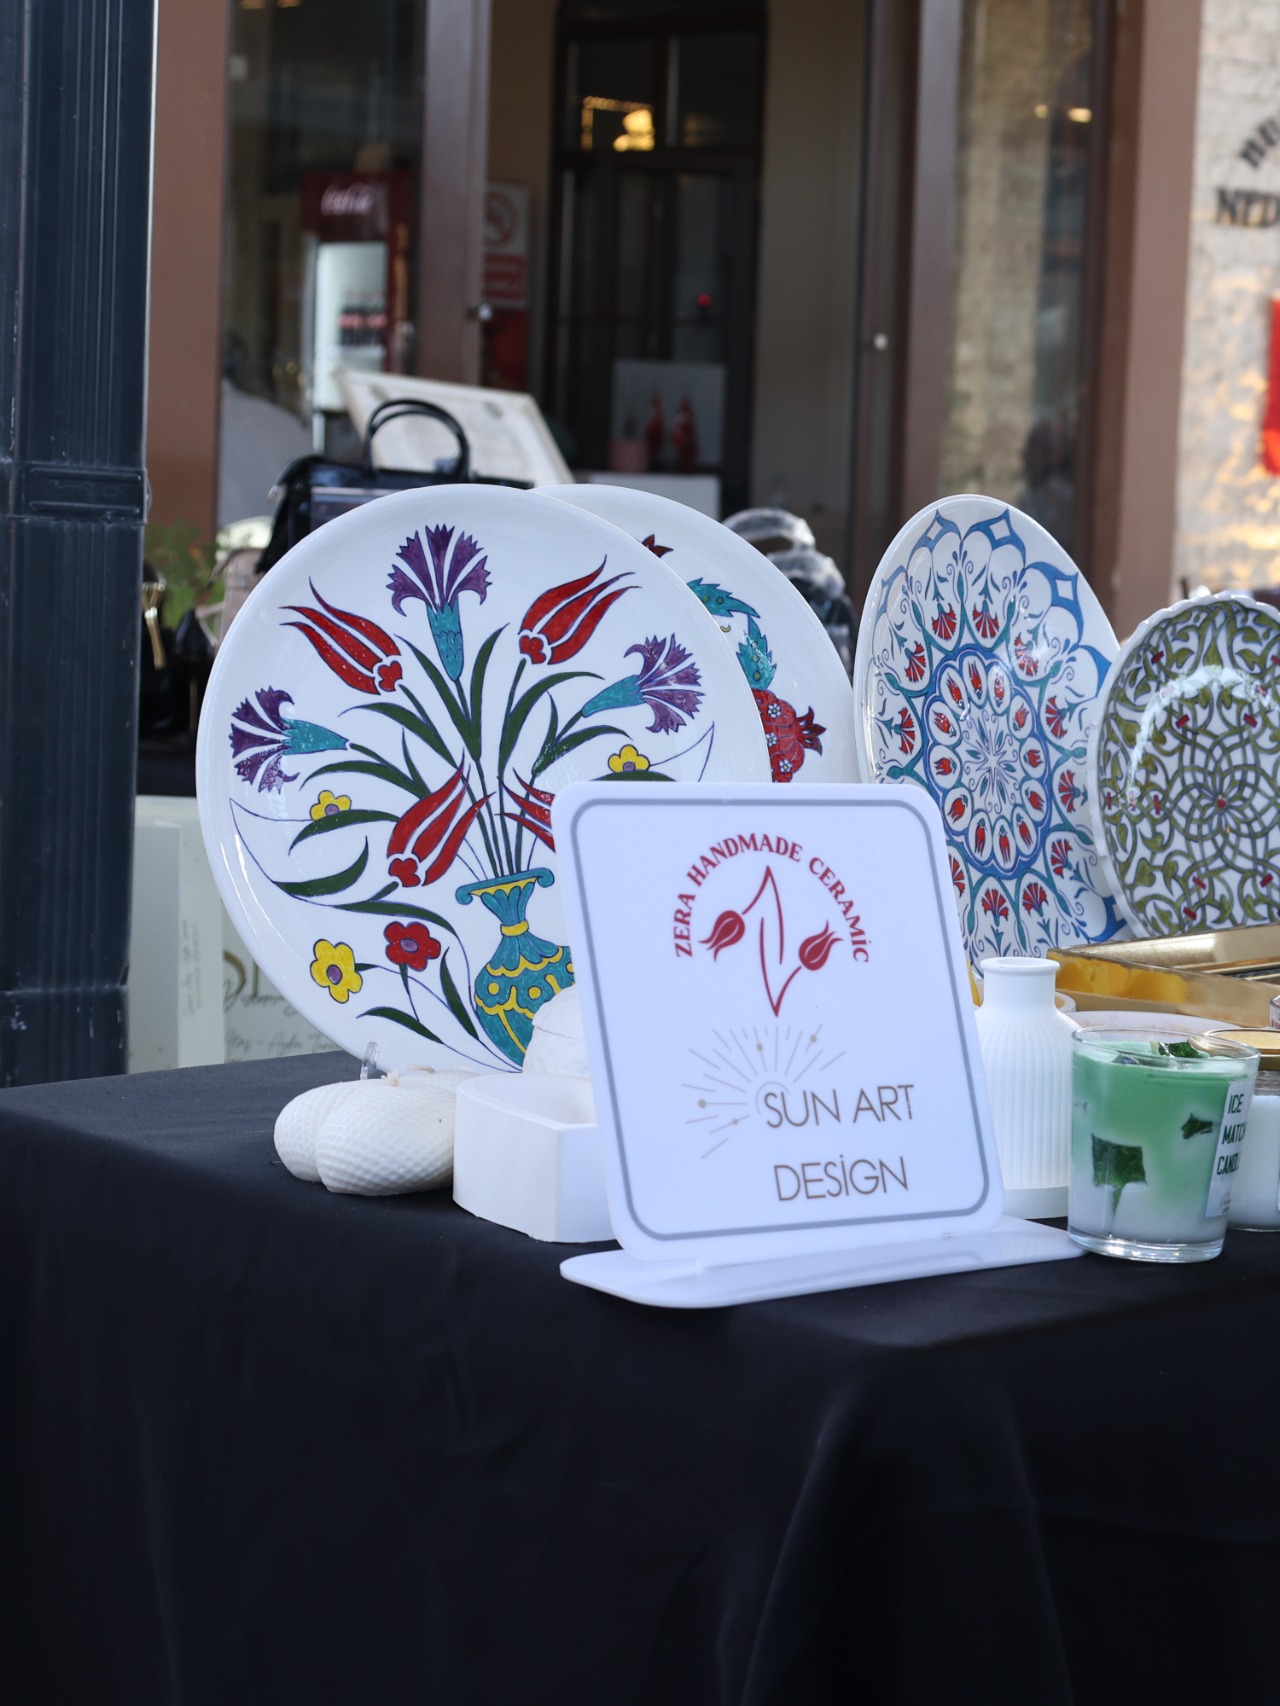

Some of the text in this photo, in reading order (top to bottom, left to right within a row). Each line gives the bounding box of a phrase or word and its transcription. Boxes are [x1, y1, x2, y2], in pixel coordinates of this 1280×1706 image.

[673, 892, 696, 958] ZERA
[686, 833, 803, 888] HANDMADE
[764, 1084, 915, 1129] SUN ART
[1227, 1093, 1245, 1115] ICE
